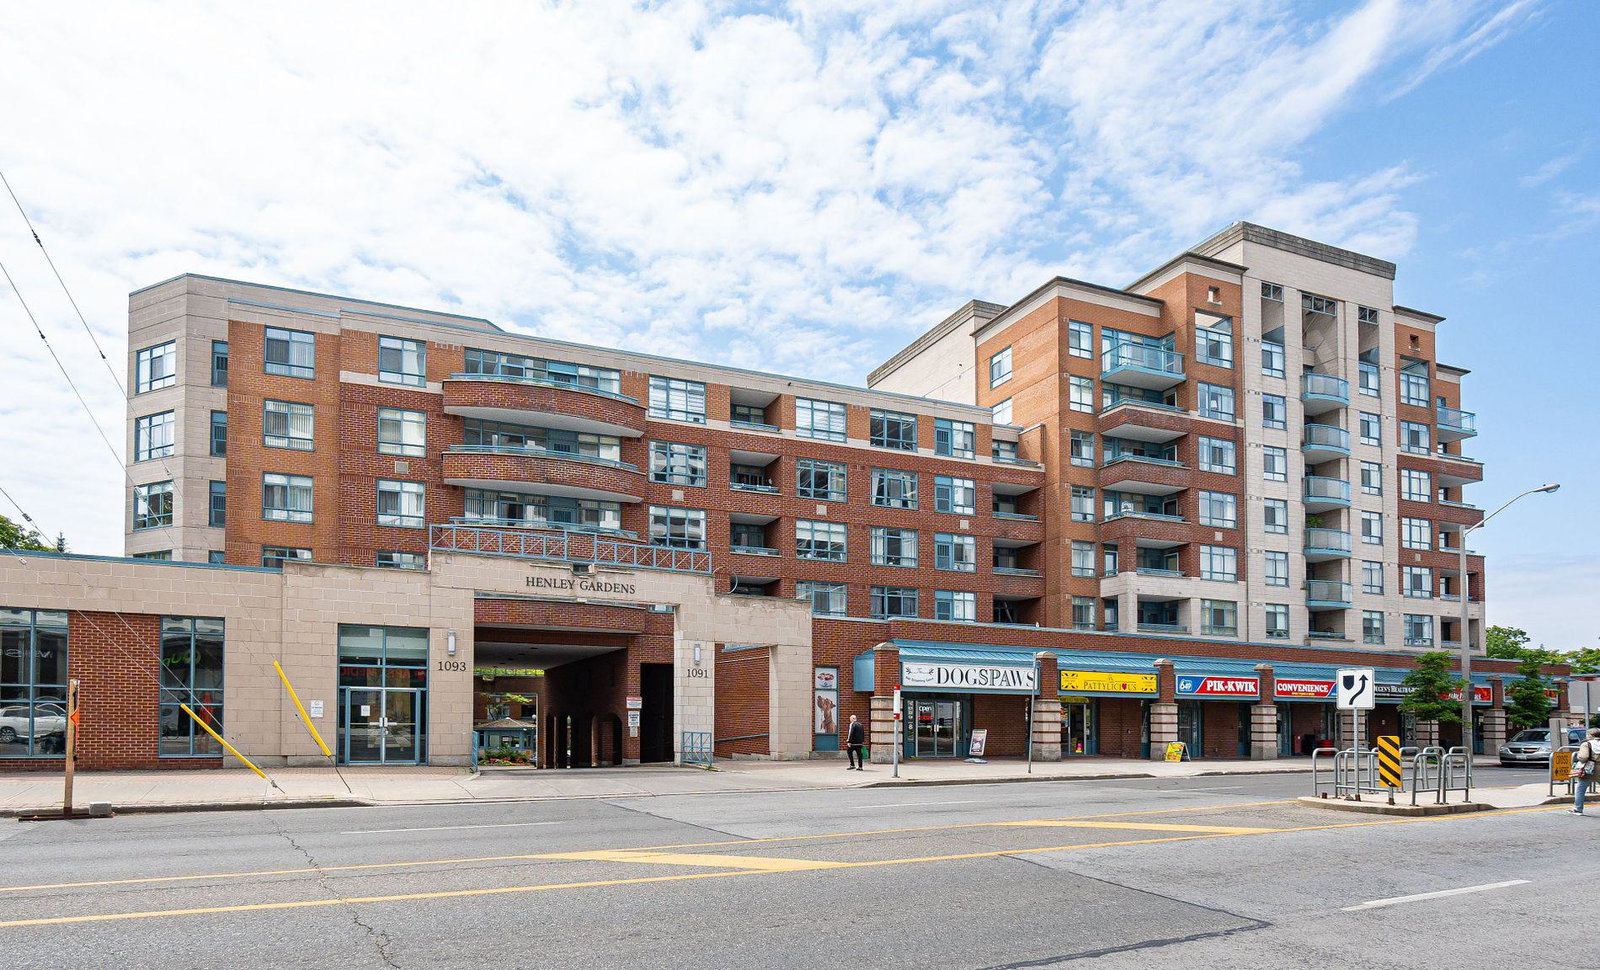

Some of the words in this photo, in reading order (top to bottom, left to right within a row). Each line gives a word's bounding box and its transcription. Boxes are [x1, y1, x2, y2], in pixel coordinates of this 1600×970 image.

[526, 576, 576, 591] HENLEY
[580, 580, 636, 595] GARDENS
[438, 661, 467, 672] 1093
[687, 668, 709, 679] 1091
[937, 667, 1034, 688] DOGSPAWS
[1206, 680, 1257, 692] PIK-KWIK
[1277, 682, 1329, 693] CONVENIENCE
